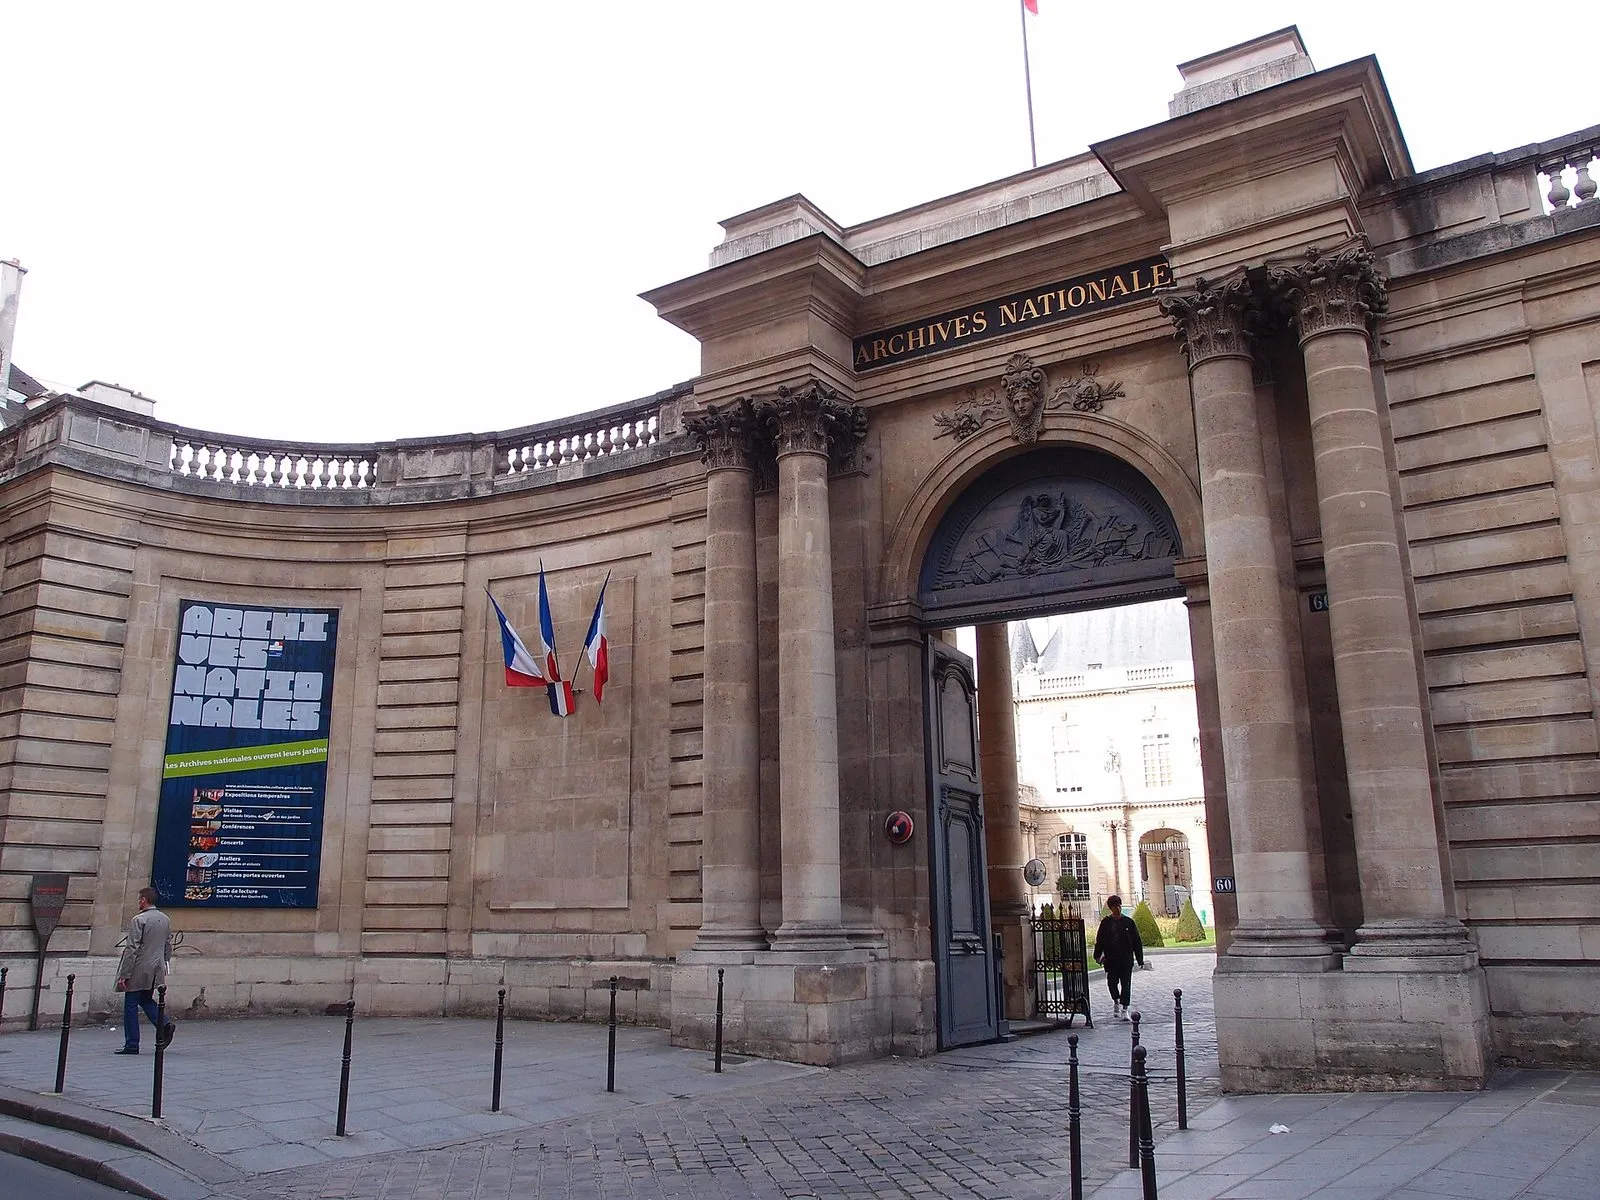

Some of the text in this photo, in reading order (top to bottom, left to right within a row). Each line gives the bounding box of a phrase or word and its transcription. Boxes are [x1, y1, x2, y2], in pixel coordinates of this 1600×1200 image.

[854, 262, 1176, 366] ARCHIVES NATIONALE
[178, 634, 269, 669] VES
[174, 665, 324, 701] NATIO
[170, 695, 321, 731] NALES
[180, 759, 212, 768] Archives
[213, 755, 252, 765] nationales
[253, 752, 282, 761] ouvrent
[282, 750, 301, 758] leurs
[302, 746, 328, 756] jardins
[1216, 879, 1231, 891] 60
